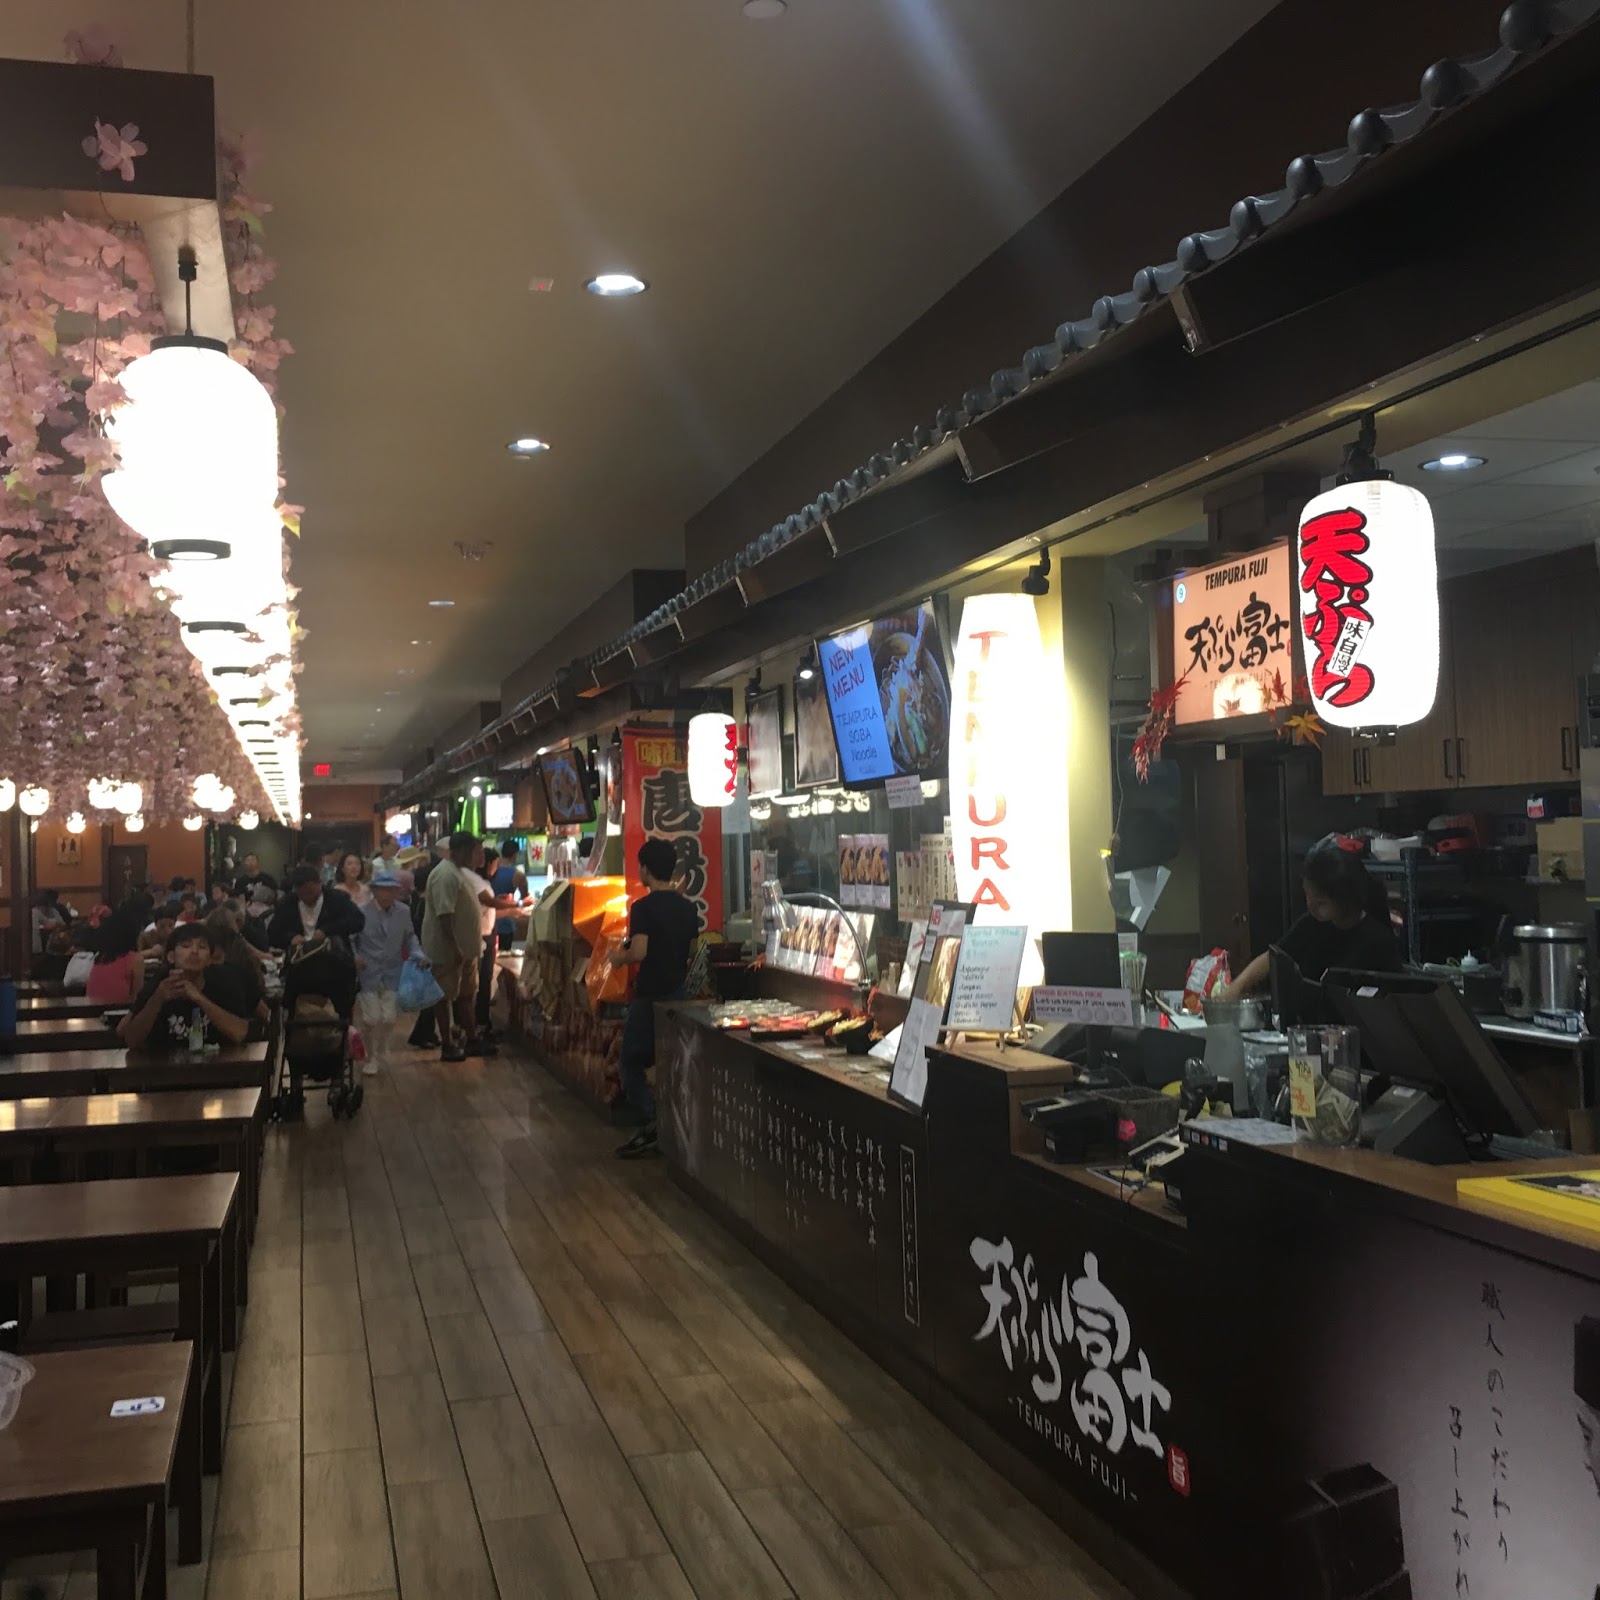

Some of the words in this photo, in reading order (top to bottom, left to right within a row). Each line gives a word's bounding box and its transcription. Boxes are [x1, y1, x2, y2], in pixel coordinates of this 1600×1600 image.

[1205, 564, 1246, 591] TEMPURA
[1249, 557, 1268, 579] FUJI
[1300, 506, 1375, 708] 天ぷら
[829, 644, 855, 676] NEW
[1331, 620, 1365, 676] 味自慢
[832, 663, 865, 702] MENU
[836, 706, 878, 727] TEMPURA
[849, 728, 872, 744] SOBA
[852, 748, 877, 762] Noodle
[965, 630, 1011, 912] TEMURA
[877, 1144, 886, 1201] 天丼
[1481, 1281, 1510, 1564] 職人のこだわり
[1016, 1396, 1083, 1467] TEMPURA
[1090, 1453, 1127, 1501] FUJI
